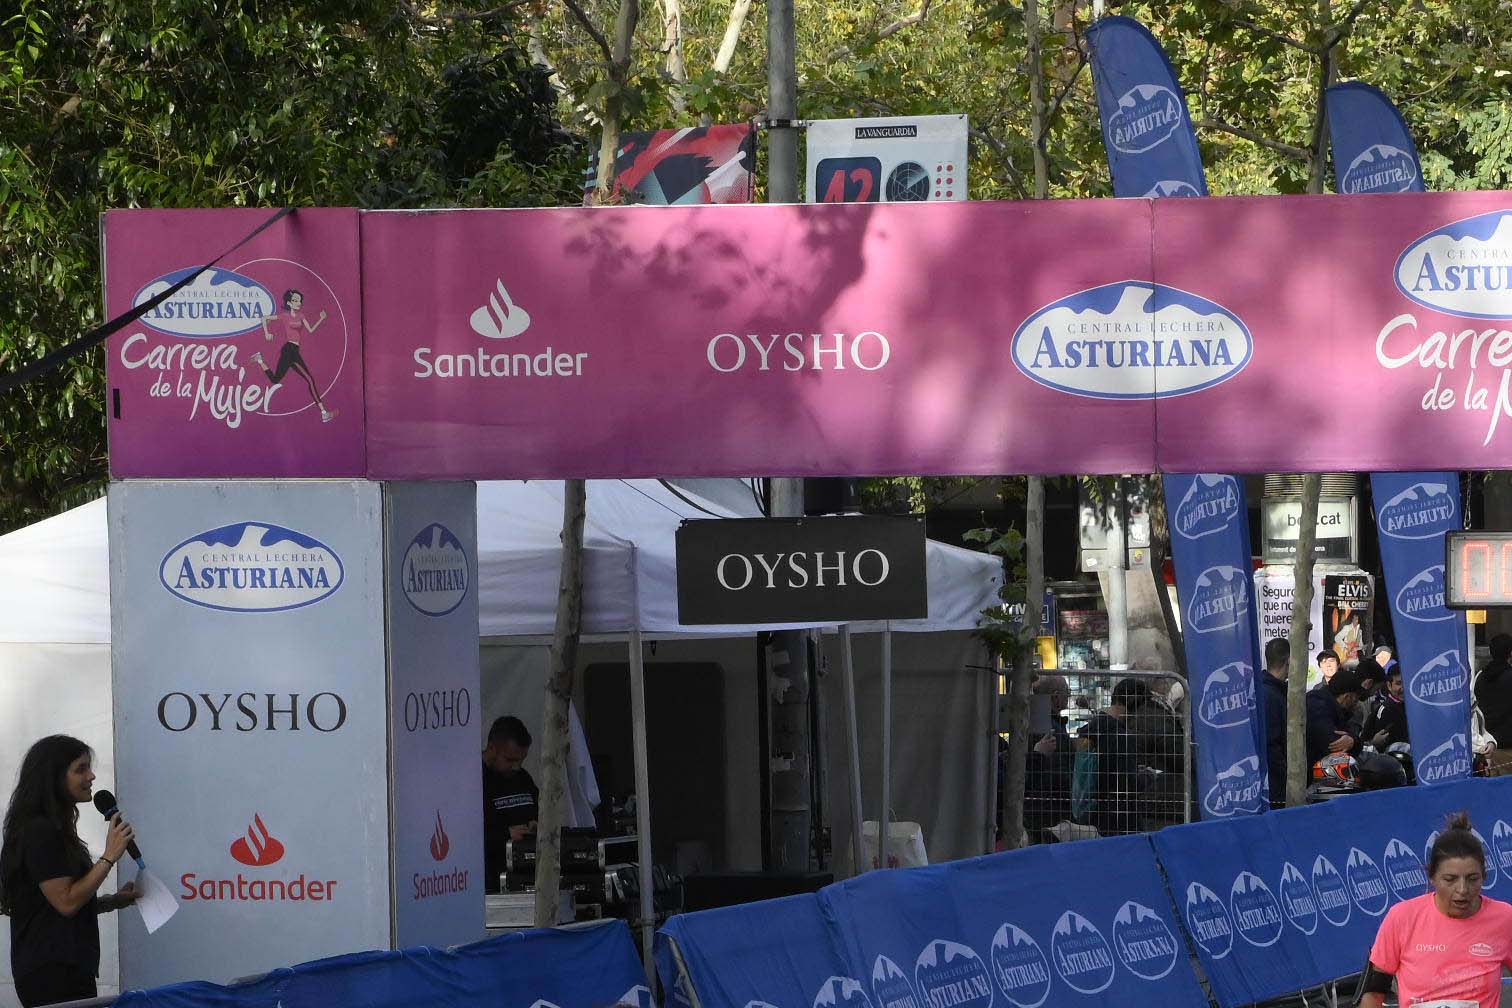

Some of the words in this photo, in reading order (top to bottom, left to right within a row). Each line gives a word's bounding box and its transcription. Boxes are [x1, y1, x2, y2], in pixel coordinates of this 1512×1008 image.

[1067, 322, 1142, 334] CENTRAL
[1150, 321, 1225, 333] LECHERA
[121, 333, 239, 370] Carrera
[413, 347, 589, 378] Santander
[707, 331, 891, 373] OYSHO
[1031, 326, 1234, 369] ASTURIANA
[150, 372, 172, 398] de
[176, 372, 192, 398] la
[190, 366, 284, 429] Mujer
[1422, 373, 1456, 411] de
[1464, 368, 1488, 411] la
[174, 555, 331, 589] ASTURIANA
[202, 553, 260, 563] CENTRAL
[266, 552, 325, 562] LECHERA
[406, 557, 465, 594] ASTURIANA
[717, 549, 890, 591] OYSHO
[1263, 601, 1280, 614] que
[1338, 584, 1368, 597] ELVIS
[157, 692, 347, 733] OYSHO
[404, 687, 471, 733] OYSHO
[180, 872, 337, 900] Santander
[412, 867, 469, 900] Santander
